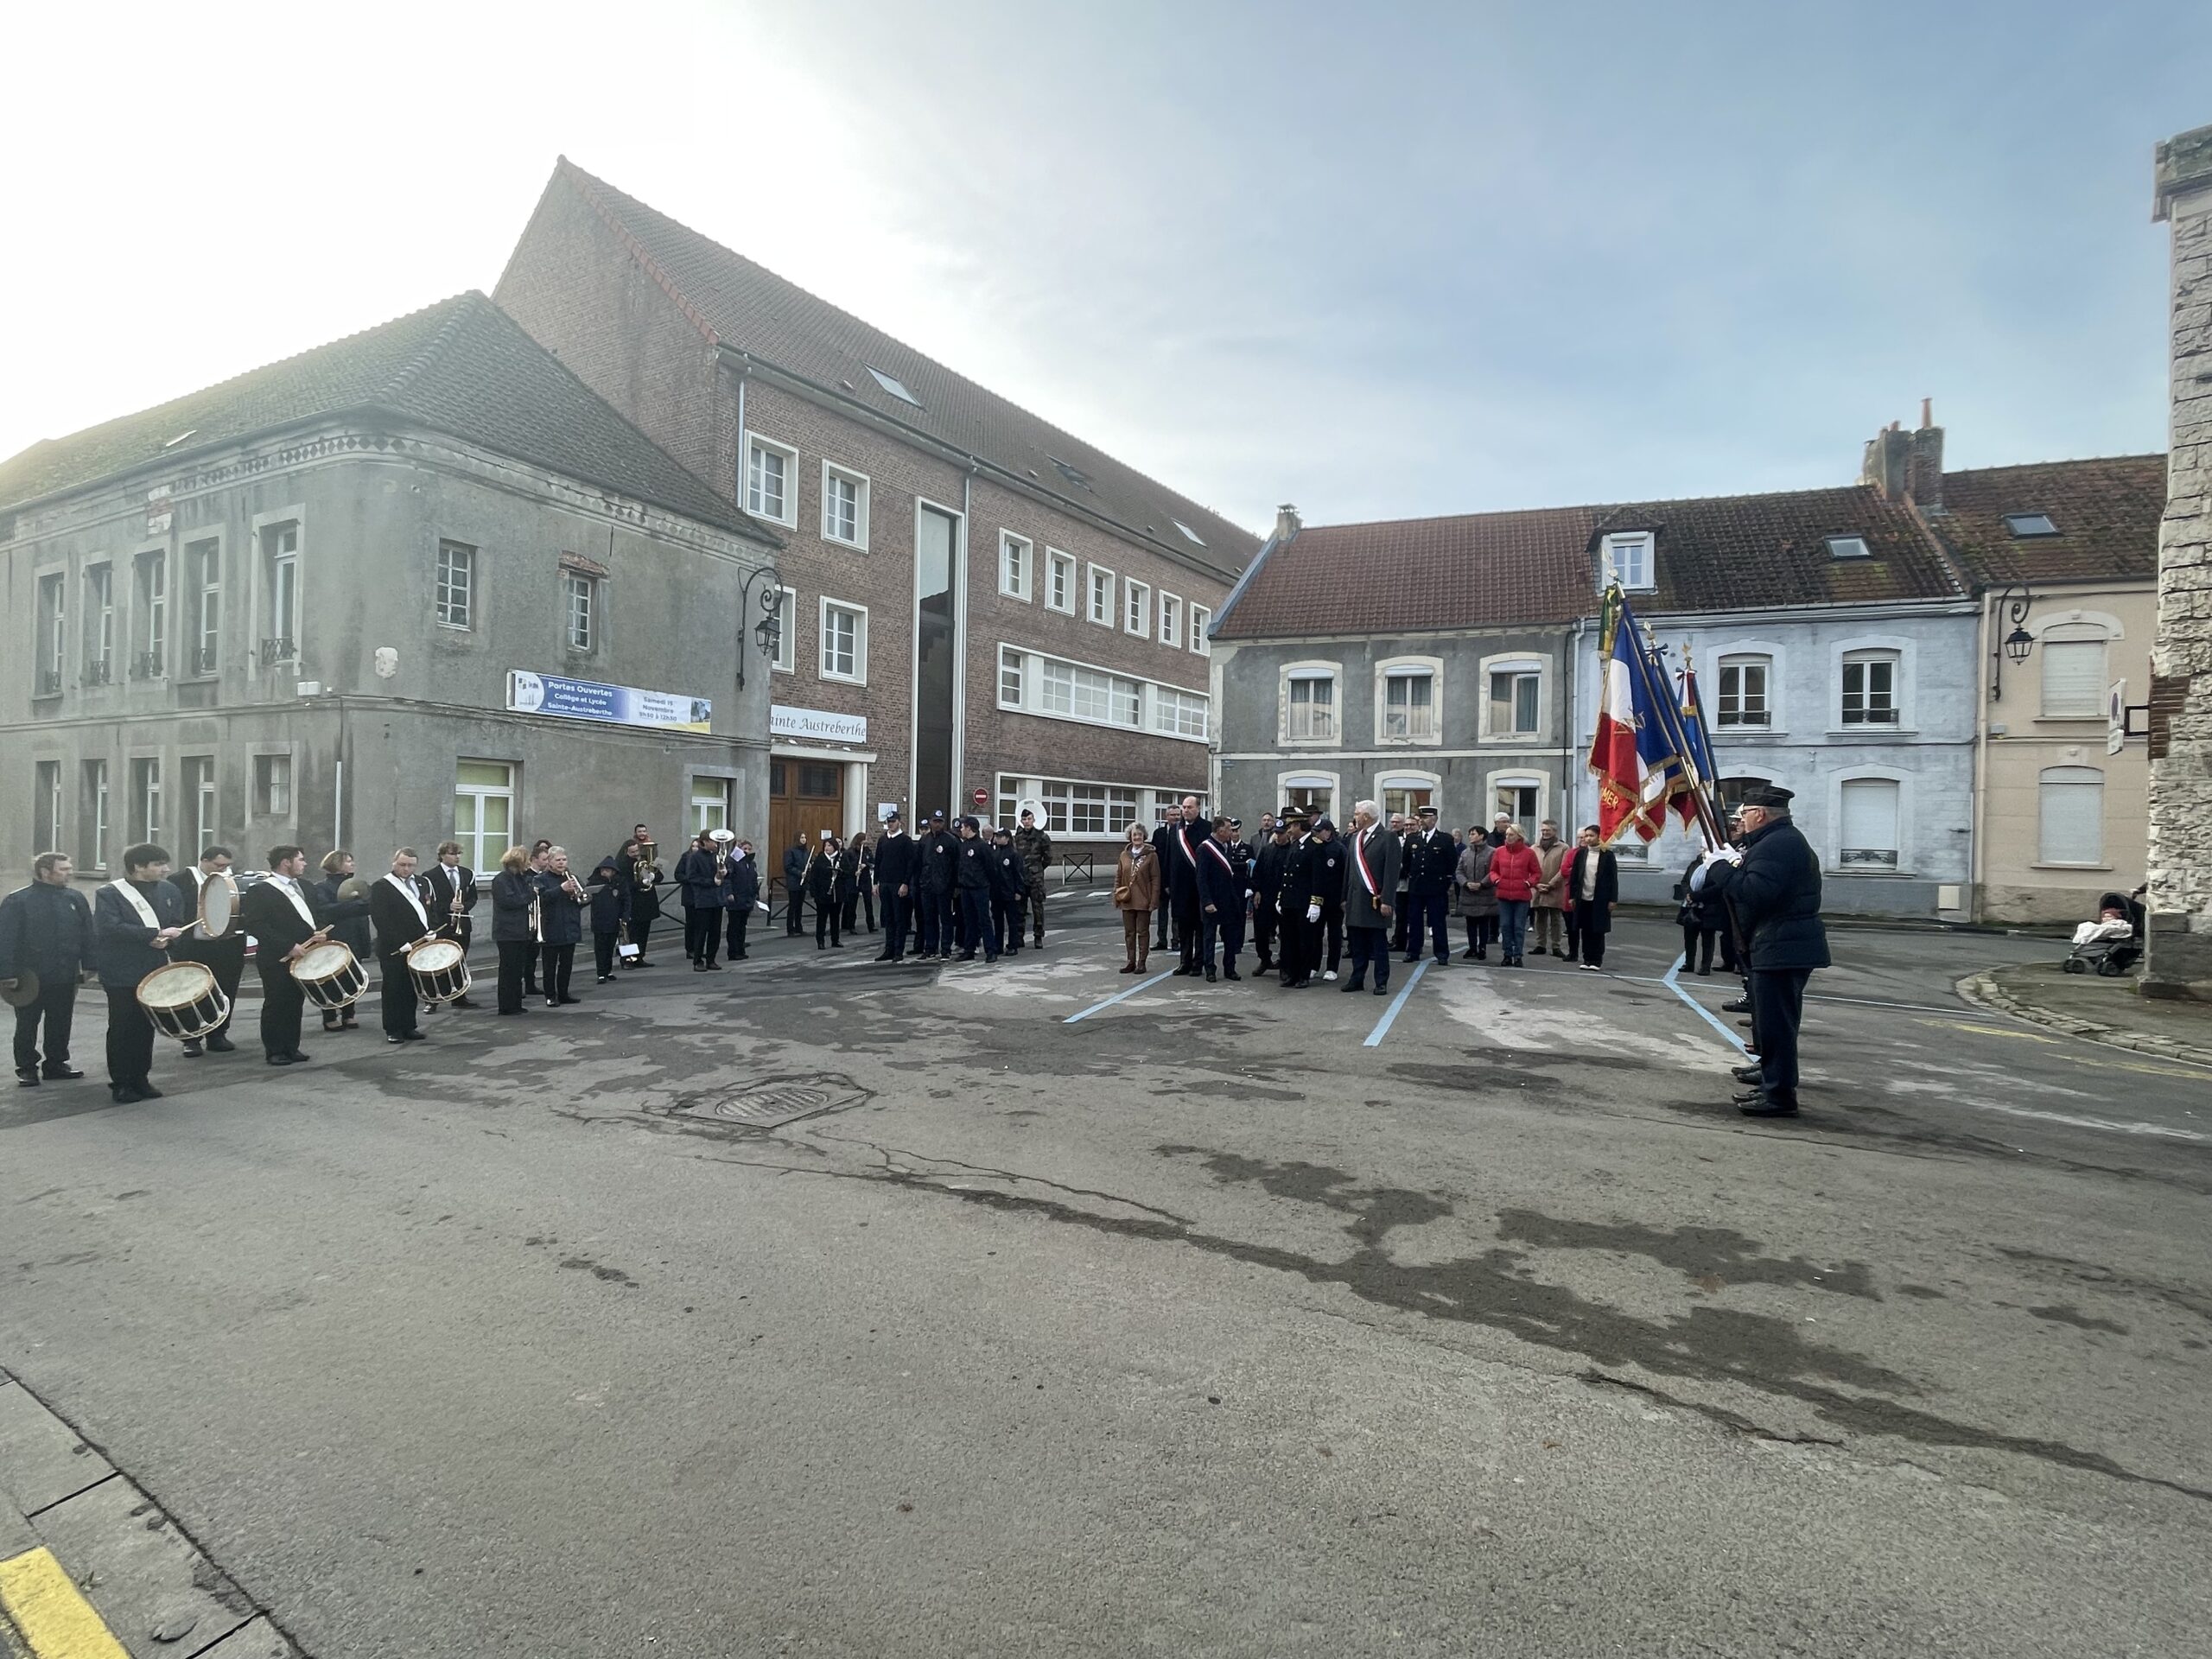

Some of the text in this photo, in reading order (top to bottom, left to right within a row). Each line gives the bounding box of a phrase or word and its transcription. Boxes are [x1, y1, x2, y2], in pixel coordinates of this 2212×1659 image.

[548, 681, 575, 691] Portes
[576, 685, 613, 697] Ouvertes
[643, 696, 666, 705] Samedi
[799, 717, 866, 737] Austreberthe
